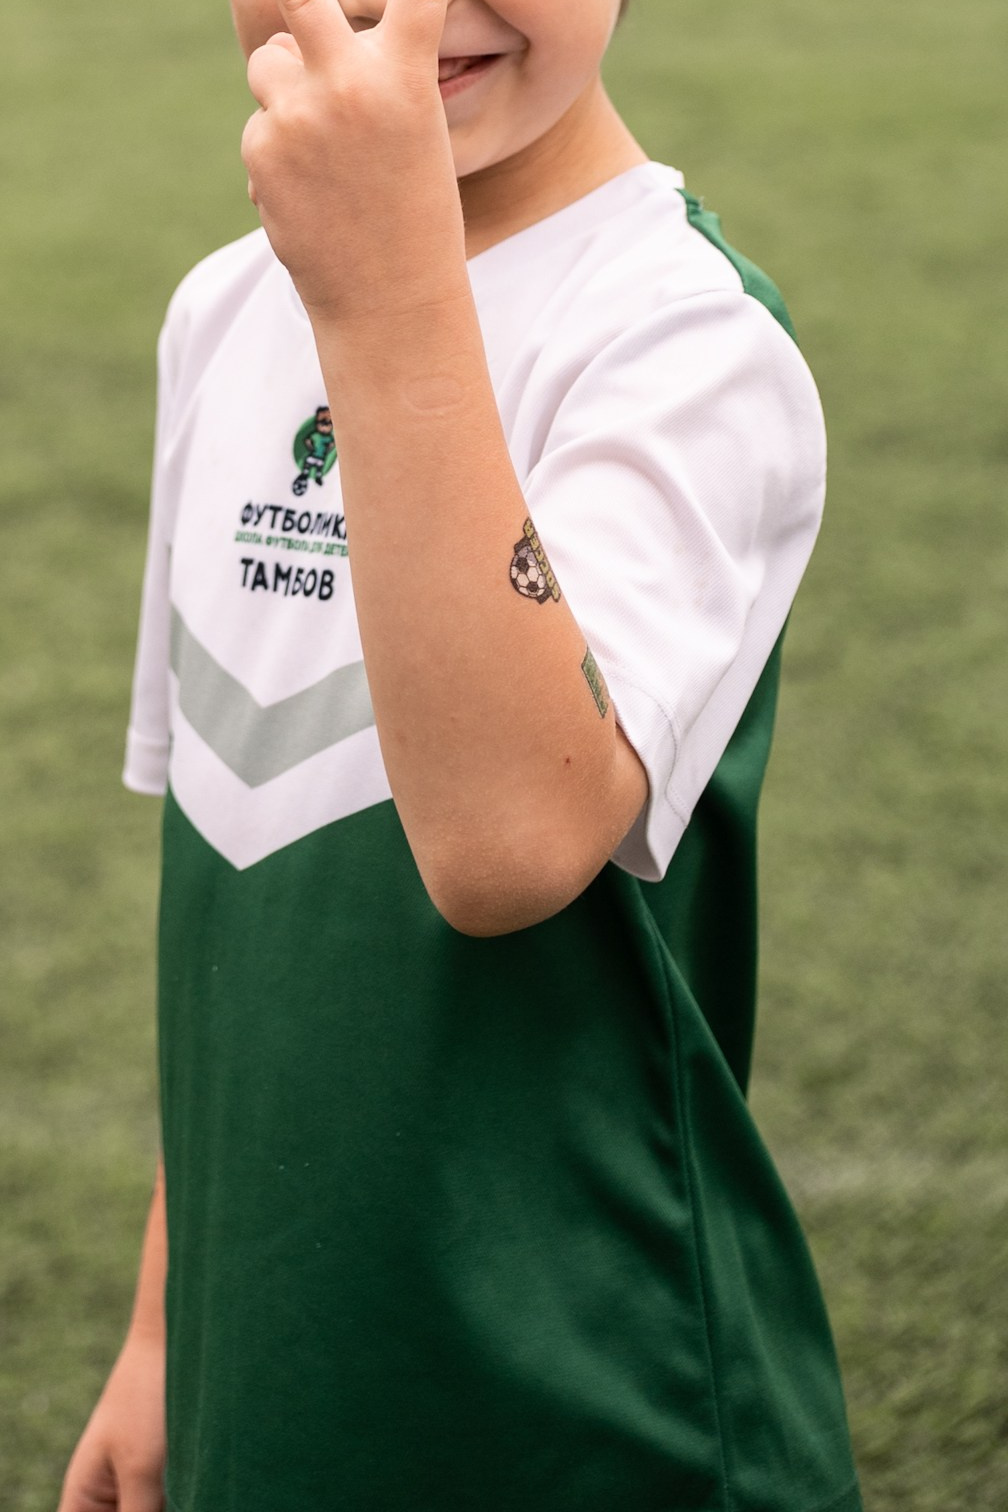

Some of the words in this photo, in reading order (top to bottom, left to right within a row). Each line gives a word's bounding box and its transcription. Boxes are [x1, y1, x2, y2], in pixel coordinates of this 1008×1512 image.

[241, 501, 347, 540] ФУТБОЛИК
[323, 541, 349, 557] ДЕТЕ
[524, 518, 561, 602] SOCCER
[240, 558, 334, 601] ТАМБОВ
